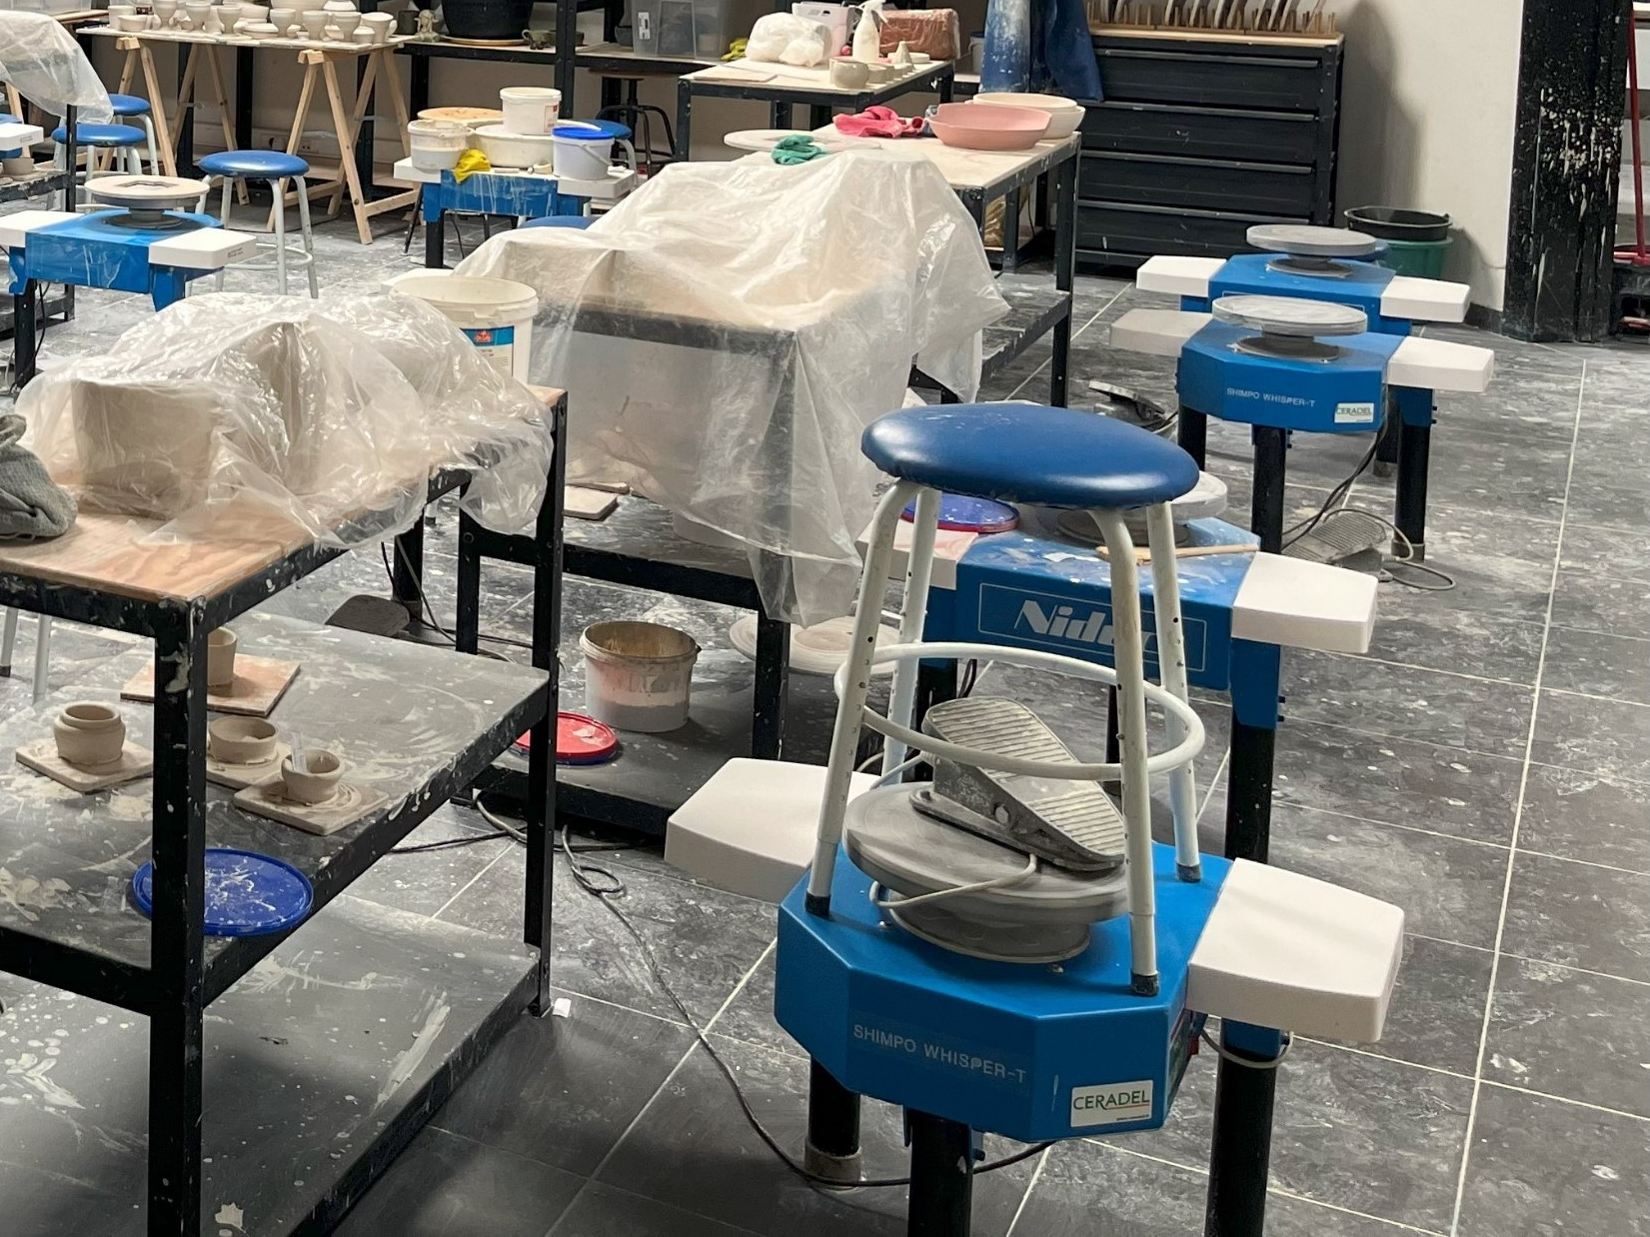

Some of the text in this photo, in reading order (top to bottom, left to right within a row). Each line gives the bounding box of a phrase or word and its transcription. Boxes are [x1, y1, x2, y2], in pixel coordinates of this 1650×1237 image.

[1226, 387, 1316, 408] SHIMPO WHISPER-T
[1336, 407, 1372, 417] CERADEL
[853, 1024, 1027, 1083] SHIMPO WHISPER-T
[1073, 1089, 1151, 1110] CERADEL
